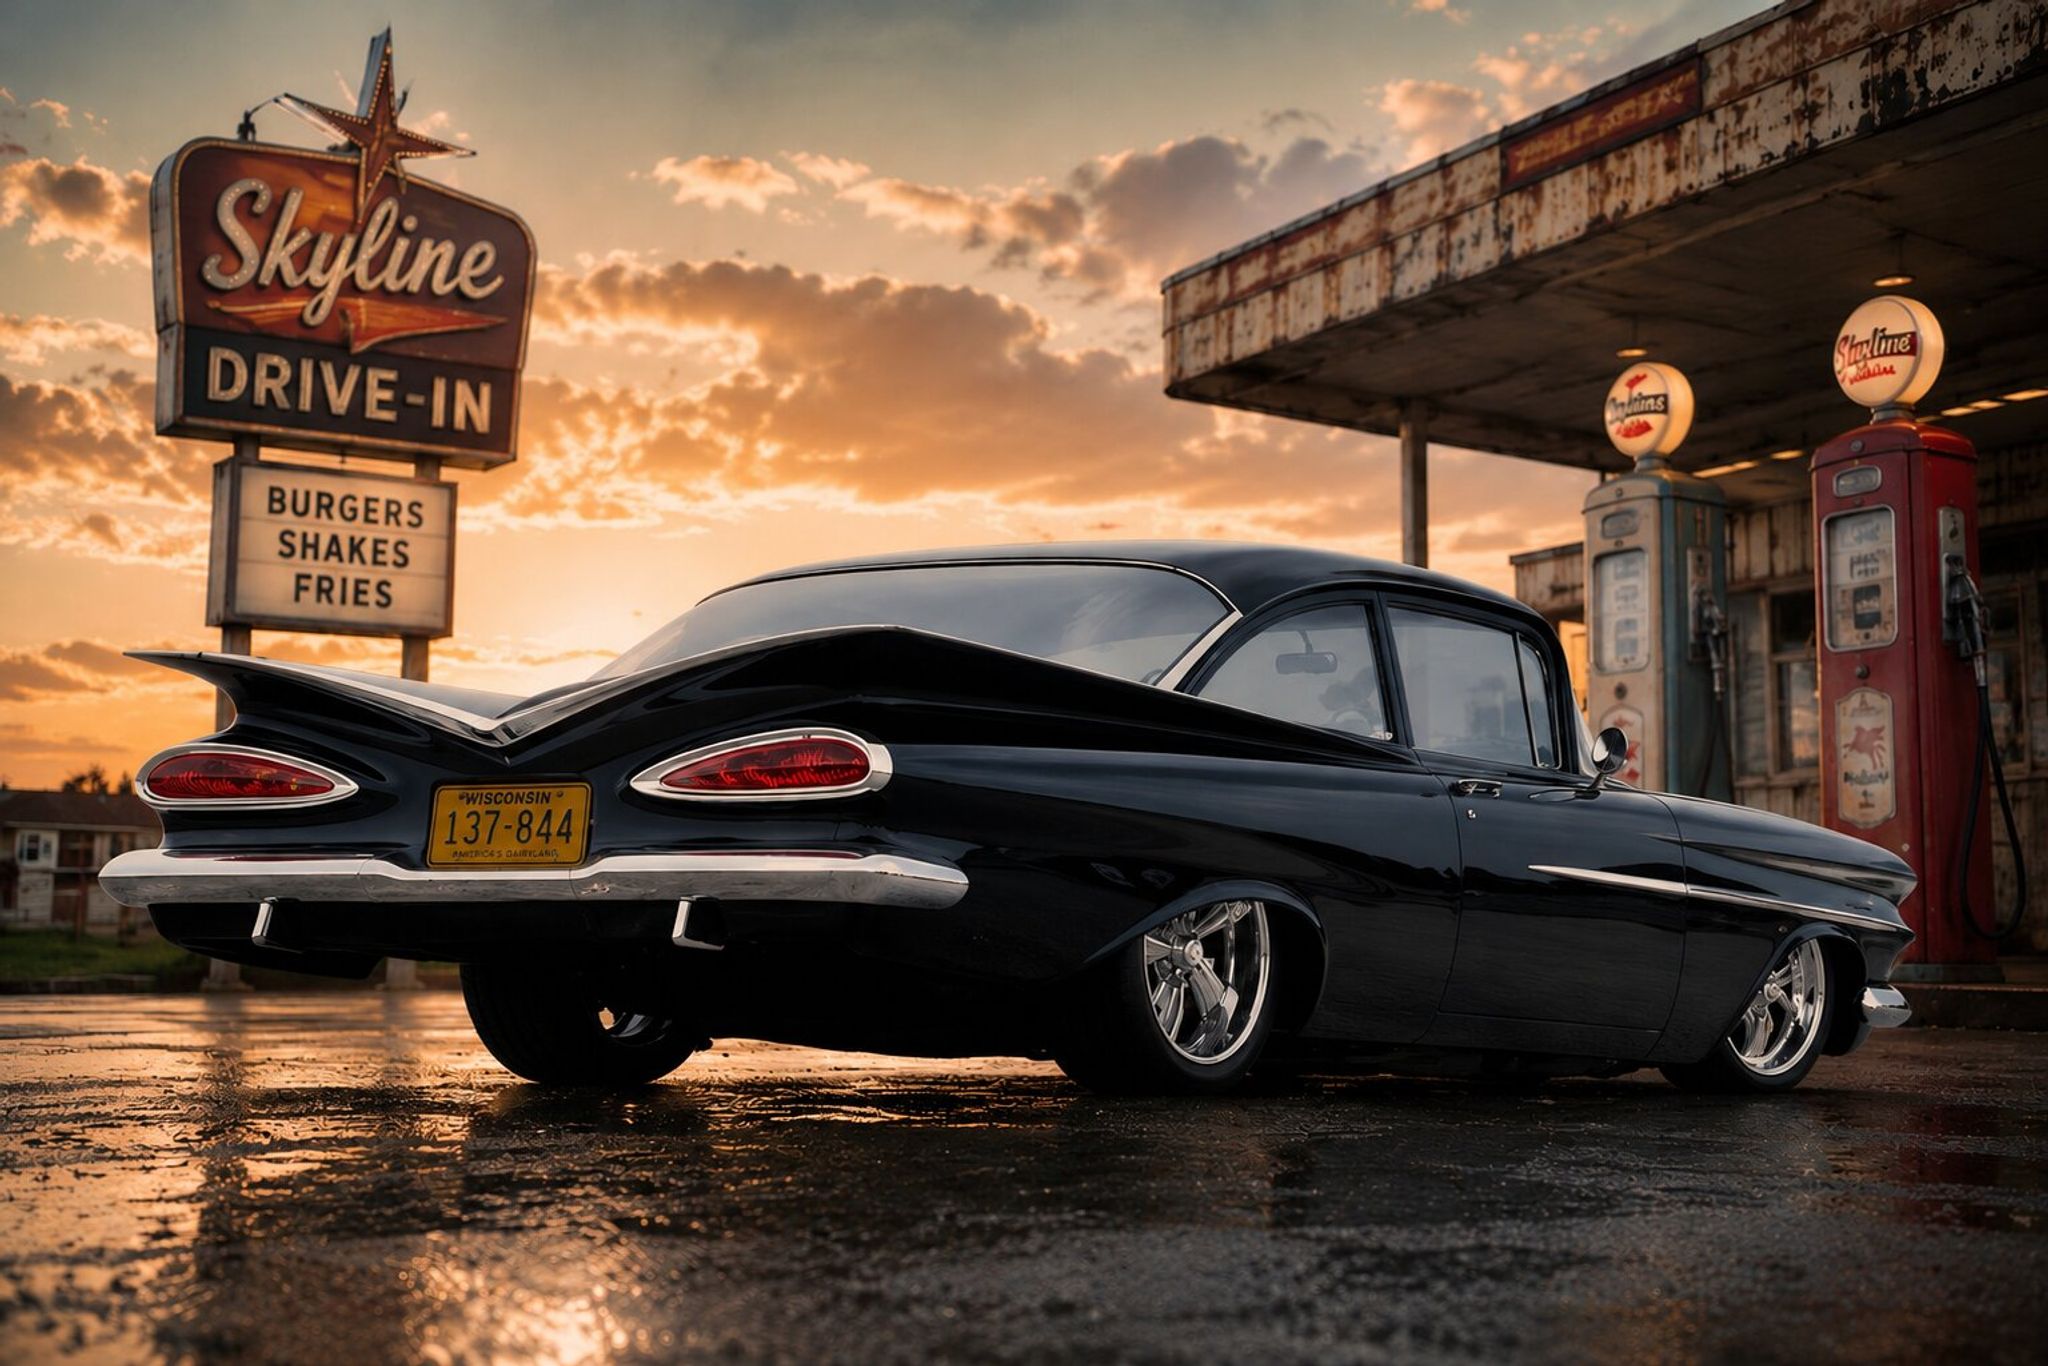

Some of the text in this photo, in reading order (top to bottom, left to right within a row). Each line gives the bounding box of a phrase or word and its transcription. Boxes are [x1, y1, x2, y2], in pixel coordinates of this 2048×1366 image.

[203, 178, 504, 326] Skyline
[207, 346, 492, 433] DRIVE-IN
[267, 485, 424, 529] BURGERS
[278, 529, 410, 569] SHAKES
[293, 573, 392, 609] FRIES
[465, 791, 552, 805] WISCONSIN
[444, 808, 573, 845] 137-844
